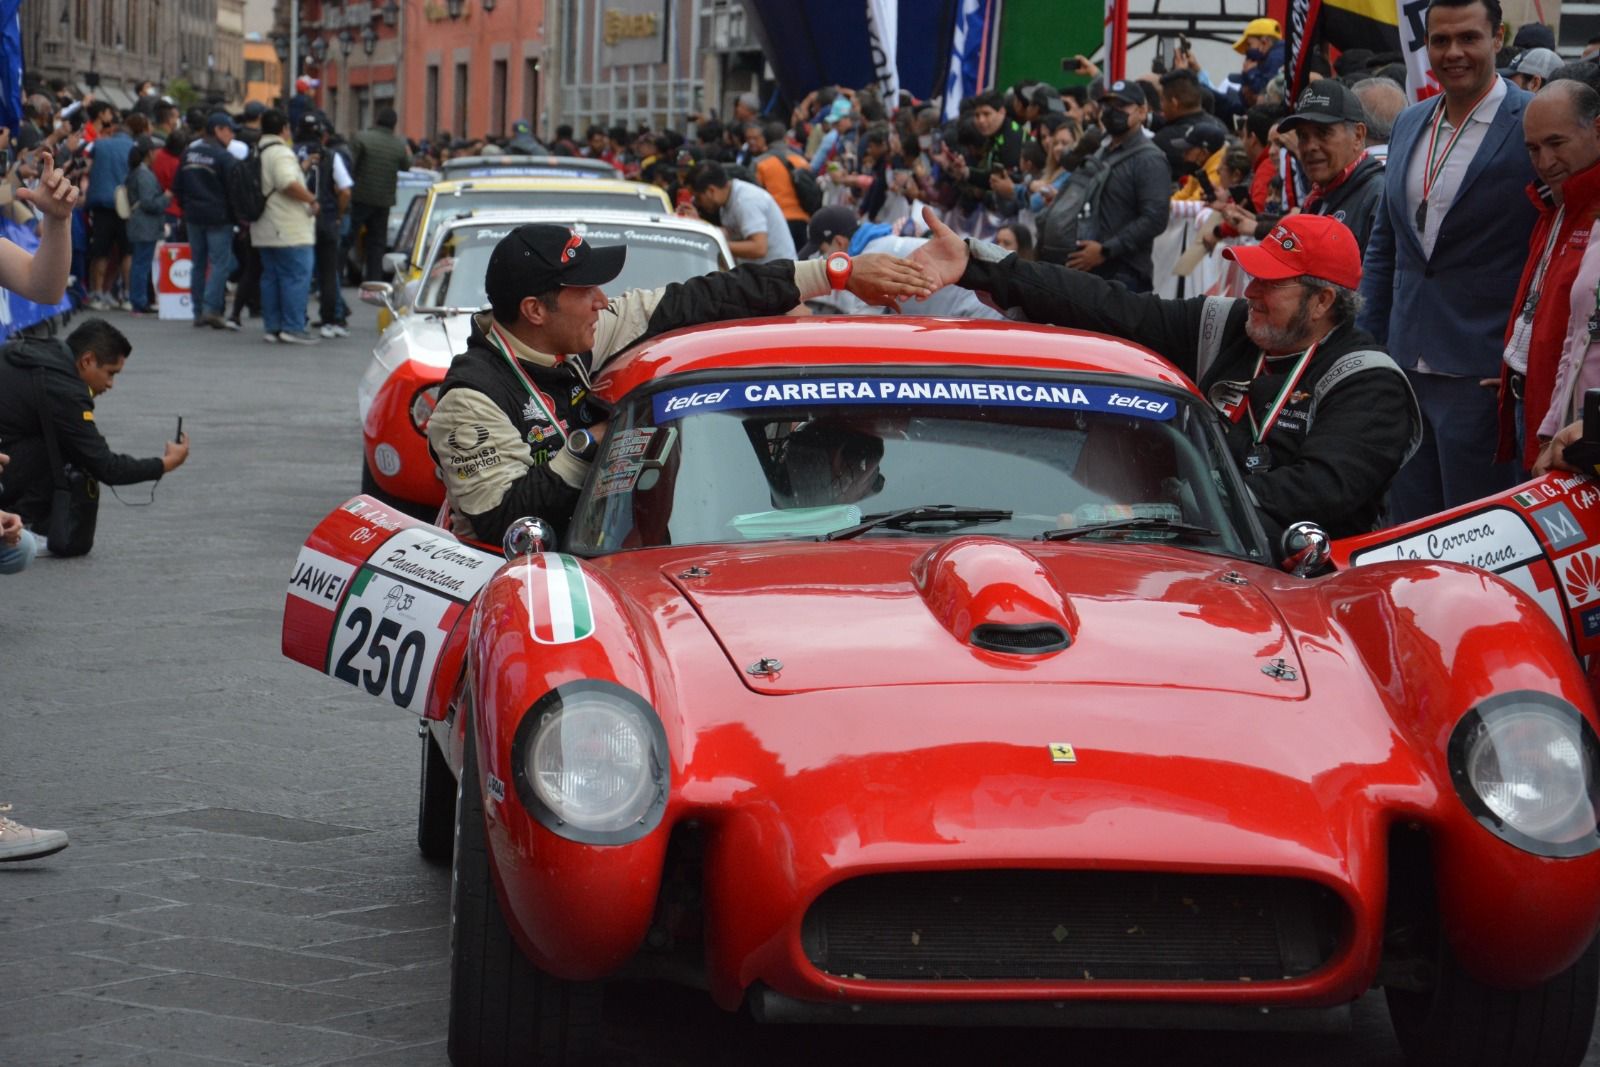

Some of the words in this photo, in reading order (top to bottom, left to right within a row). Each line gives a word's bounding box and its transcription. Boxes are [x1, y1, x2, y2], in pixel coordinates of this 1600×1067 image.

[663, 388, 730, 413] telcel
[745, 382, 876, 402] CARRERA
[879, 382, 1090, 405] PANAMERICANA
[1107, 393, 1169, 414] telcel
[450, 447, 496, 465] Televisa
[1540, 483, 1561, 498] G.
[1427, 524, 1495, 559] Carrera
[1542, 511, 1581, 544] M
[381, 549, 465, 591] Panamericana
[411, 538, 438, 552] La
[430, 545, 484, 570] Carrera
[334, 606, 426, 709] 250
